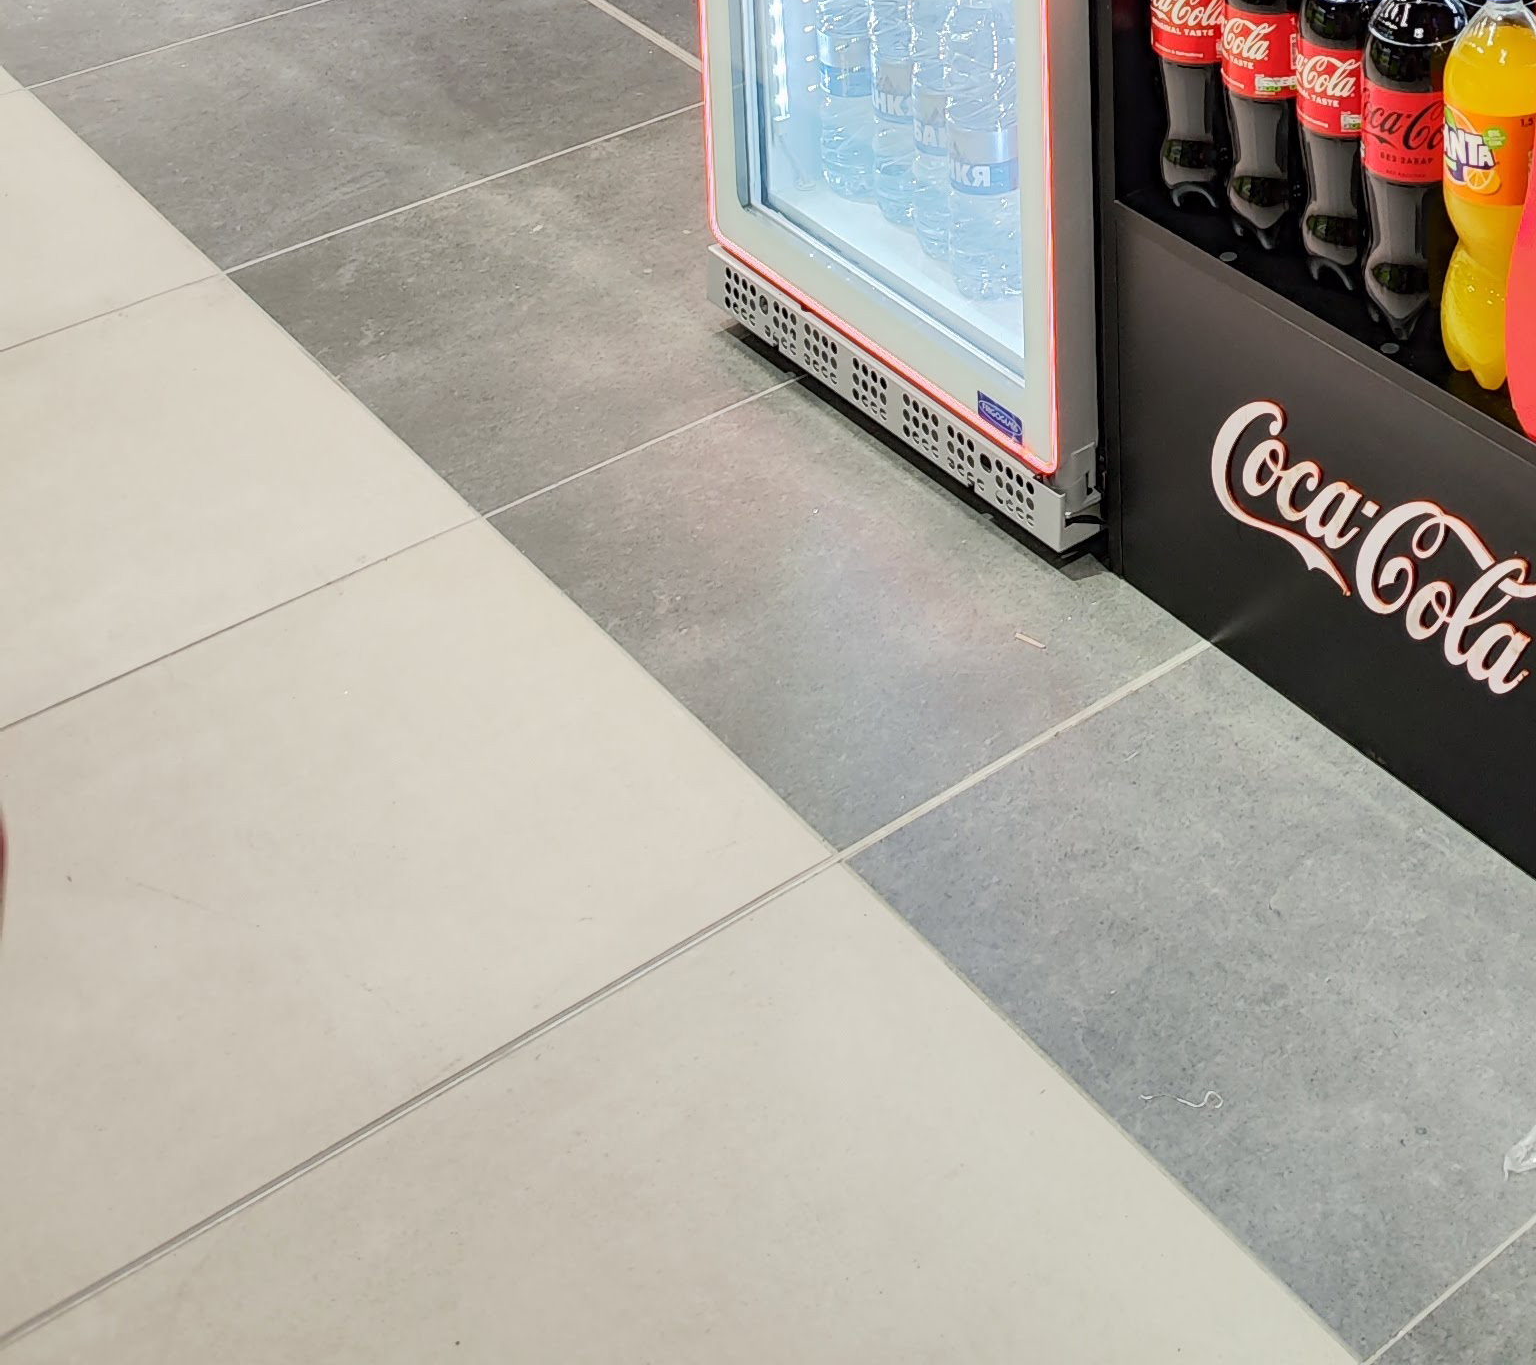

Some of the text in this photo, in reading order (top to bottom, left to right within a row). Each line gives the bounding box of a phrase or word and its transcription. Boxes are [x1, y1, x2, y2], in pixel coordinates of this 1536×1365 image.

[1184, 28, 1214, 37] TASTE
[1229, 53, 1254, 69] TASTE
[1311, 94, 1340, 108] TASTE
[1445, 125, 1497, 167] ANTA
